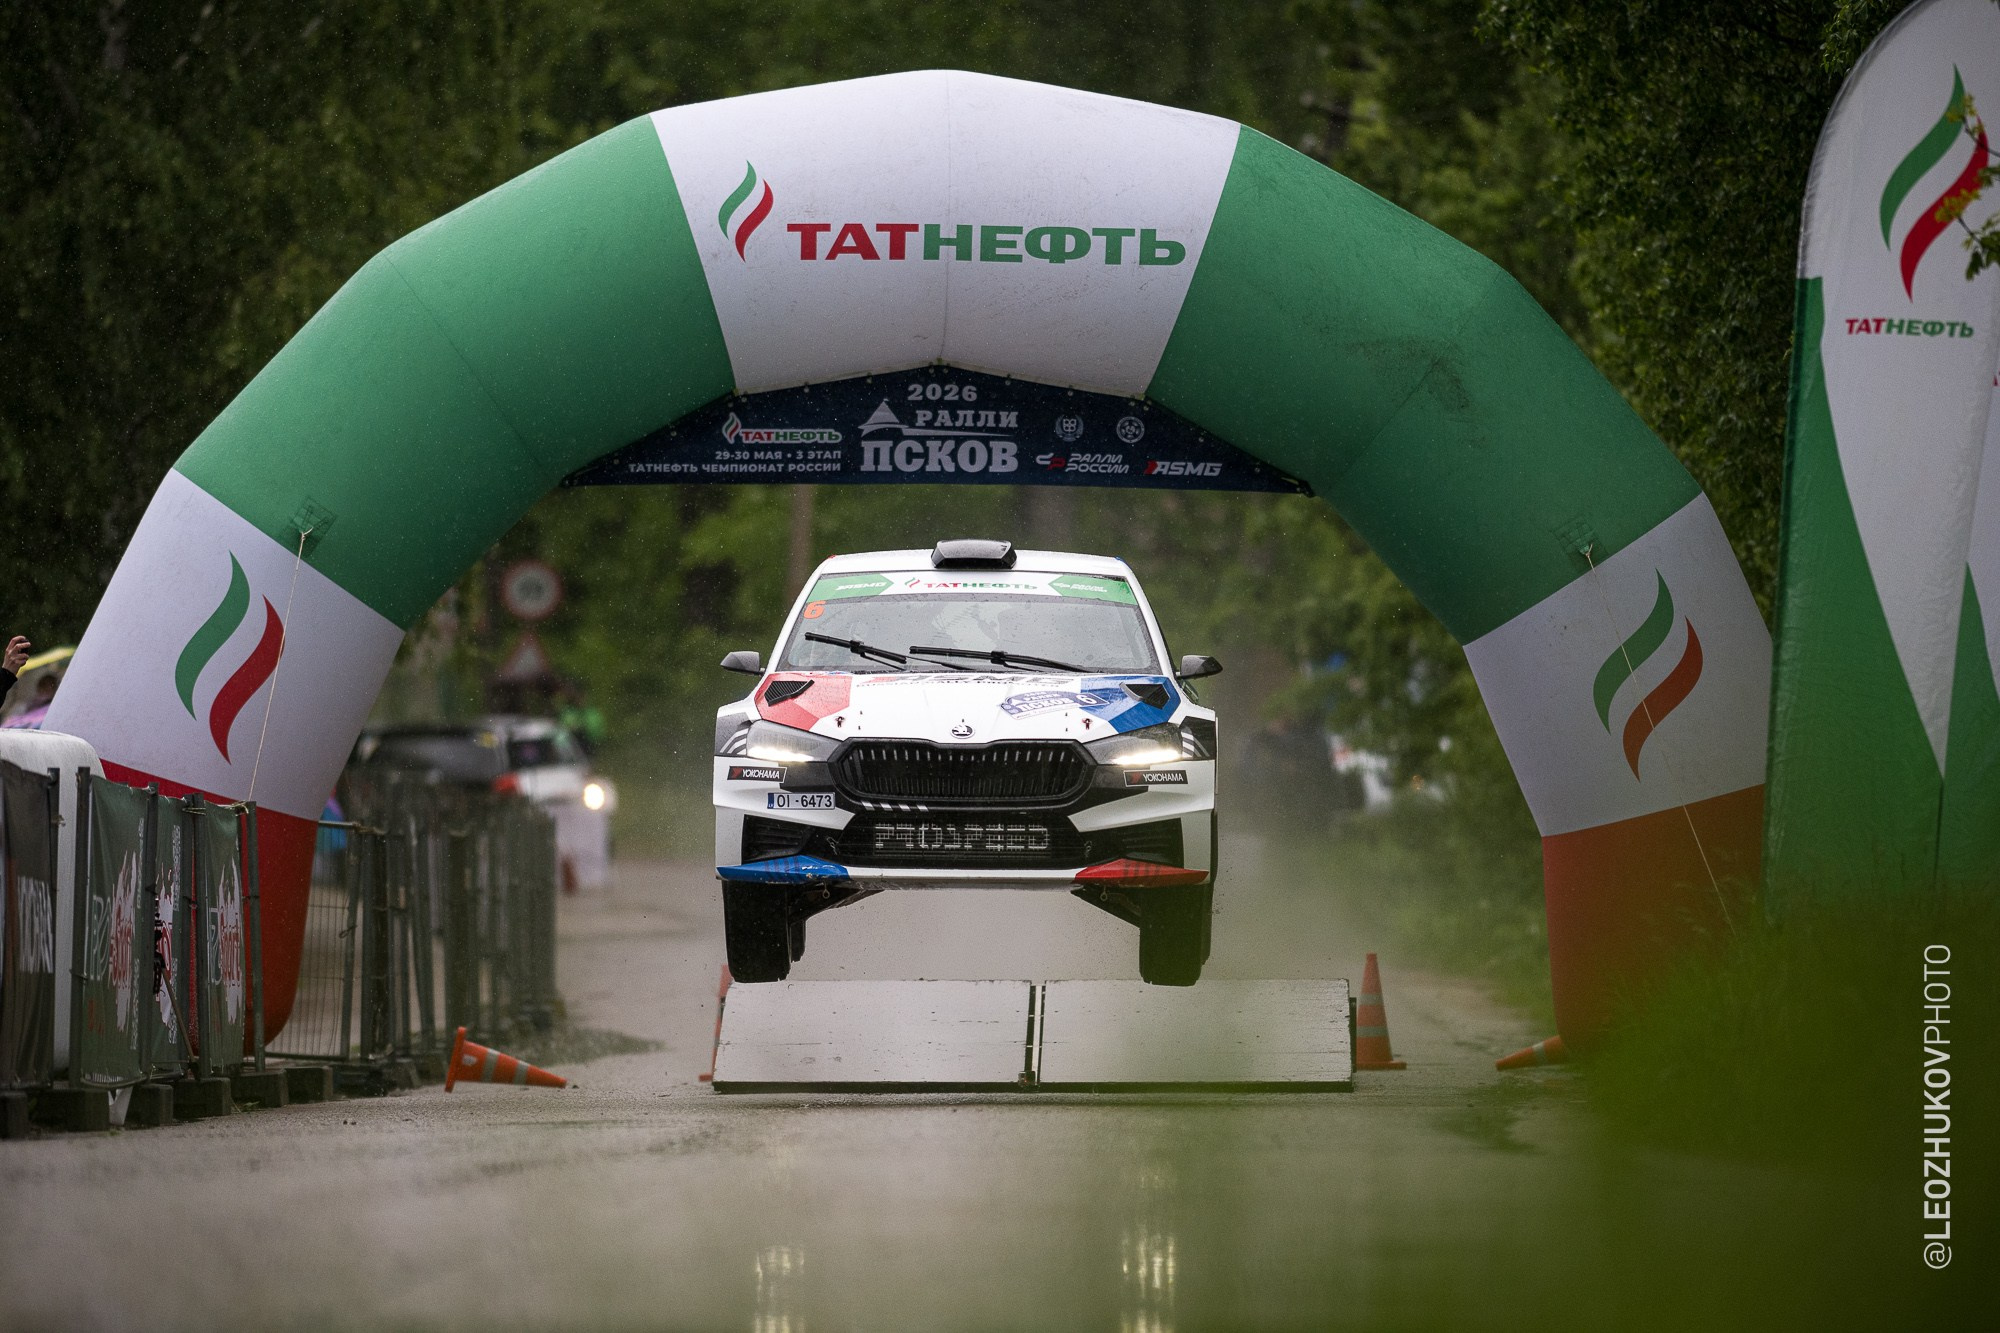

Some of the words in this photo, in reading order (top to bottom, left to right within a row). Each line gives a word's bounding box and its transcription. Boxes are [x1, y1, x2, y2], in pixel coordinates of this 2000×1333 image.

[786, 223, 1187, 266] ТАТНЕФТЬ
[1845, 317, 1975, 339] ТАТНЕФТЬ
[907, 383, 978, 402] 2026
[915, 410, 1019, 428] РАЛЛИ
[741, 429, 842, 444] ТАТНЕФТЬ
[715, 451, 750, 460] 29-30
[754, 451, 783, 460] МАЯ
[807, 450, 842, 460] ЭТАП
[860, 440, 1019, 473] ПСКОВ
[1069, 453, 1123, 463] РАЛЛИ
[629, 463, 699, 473] ТАТНЕФТЬ
[702, 463, 785, 473] ЧЕМПИОНАТ
[788, 462, 842, 472] РОССИИ
[1065, 463, 1130, 474] РОССИИ
[1152, 461, 1223, 477] ASMG
[803, 600, 827, 619] 6
[1076, 694, 1097, 705] 6
[742, 768, 780, 780] YOKOHAMA
[1143, 773, 1184, 782] YOKOHAMA
